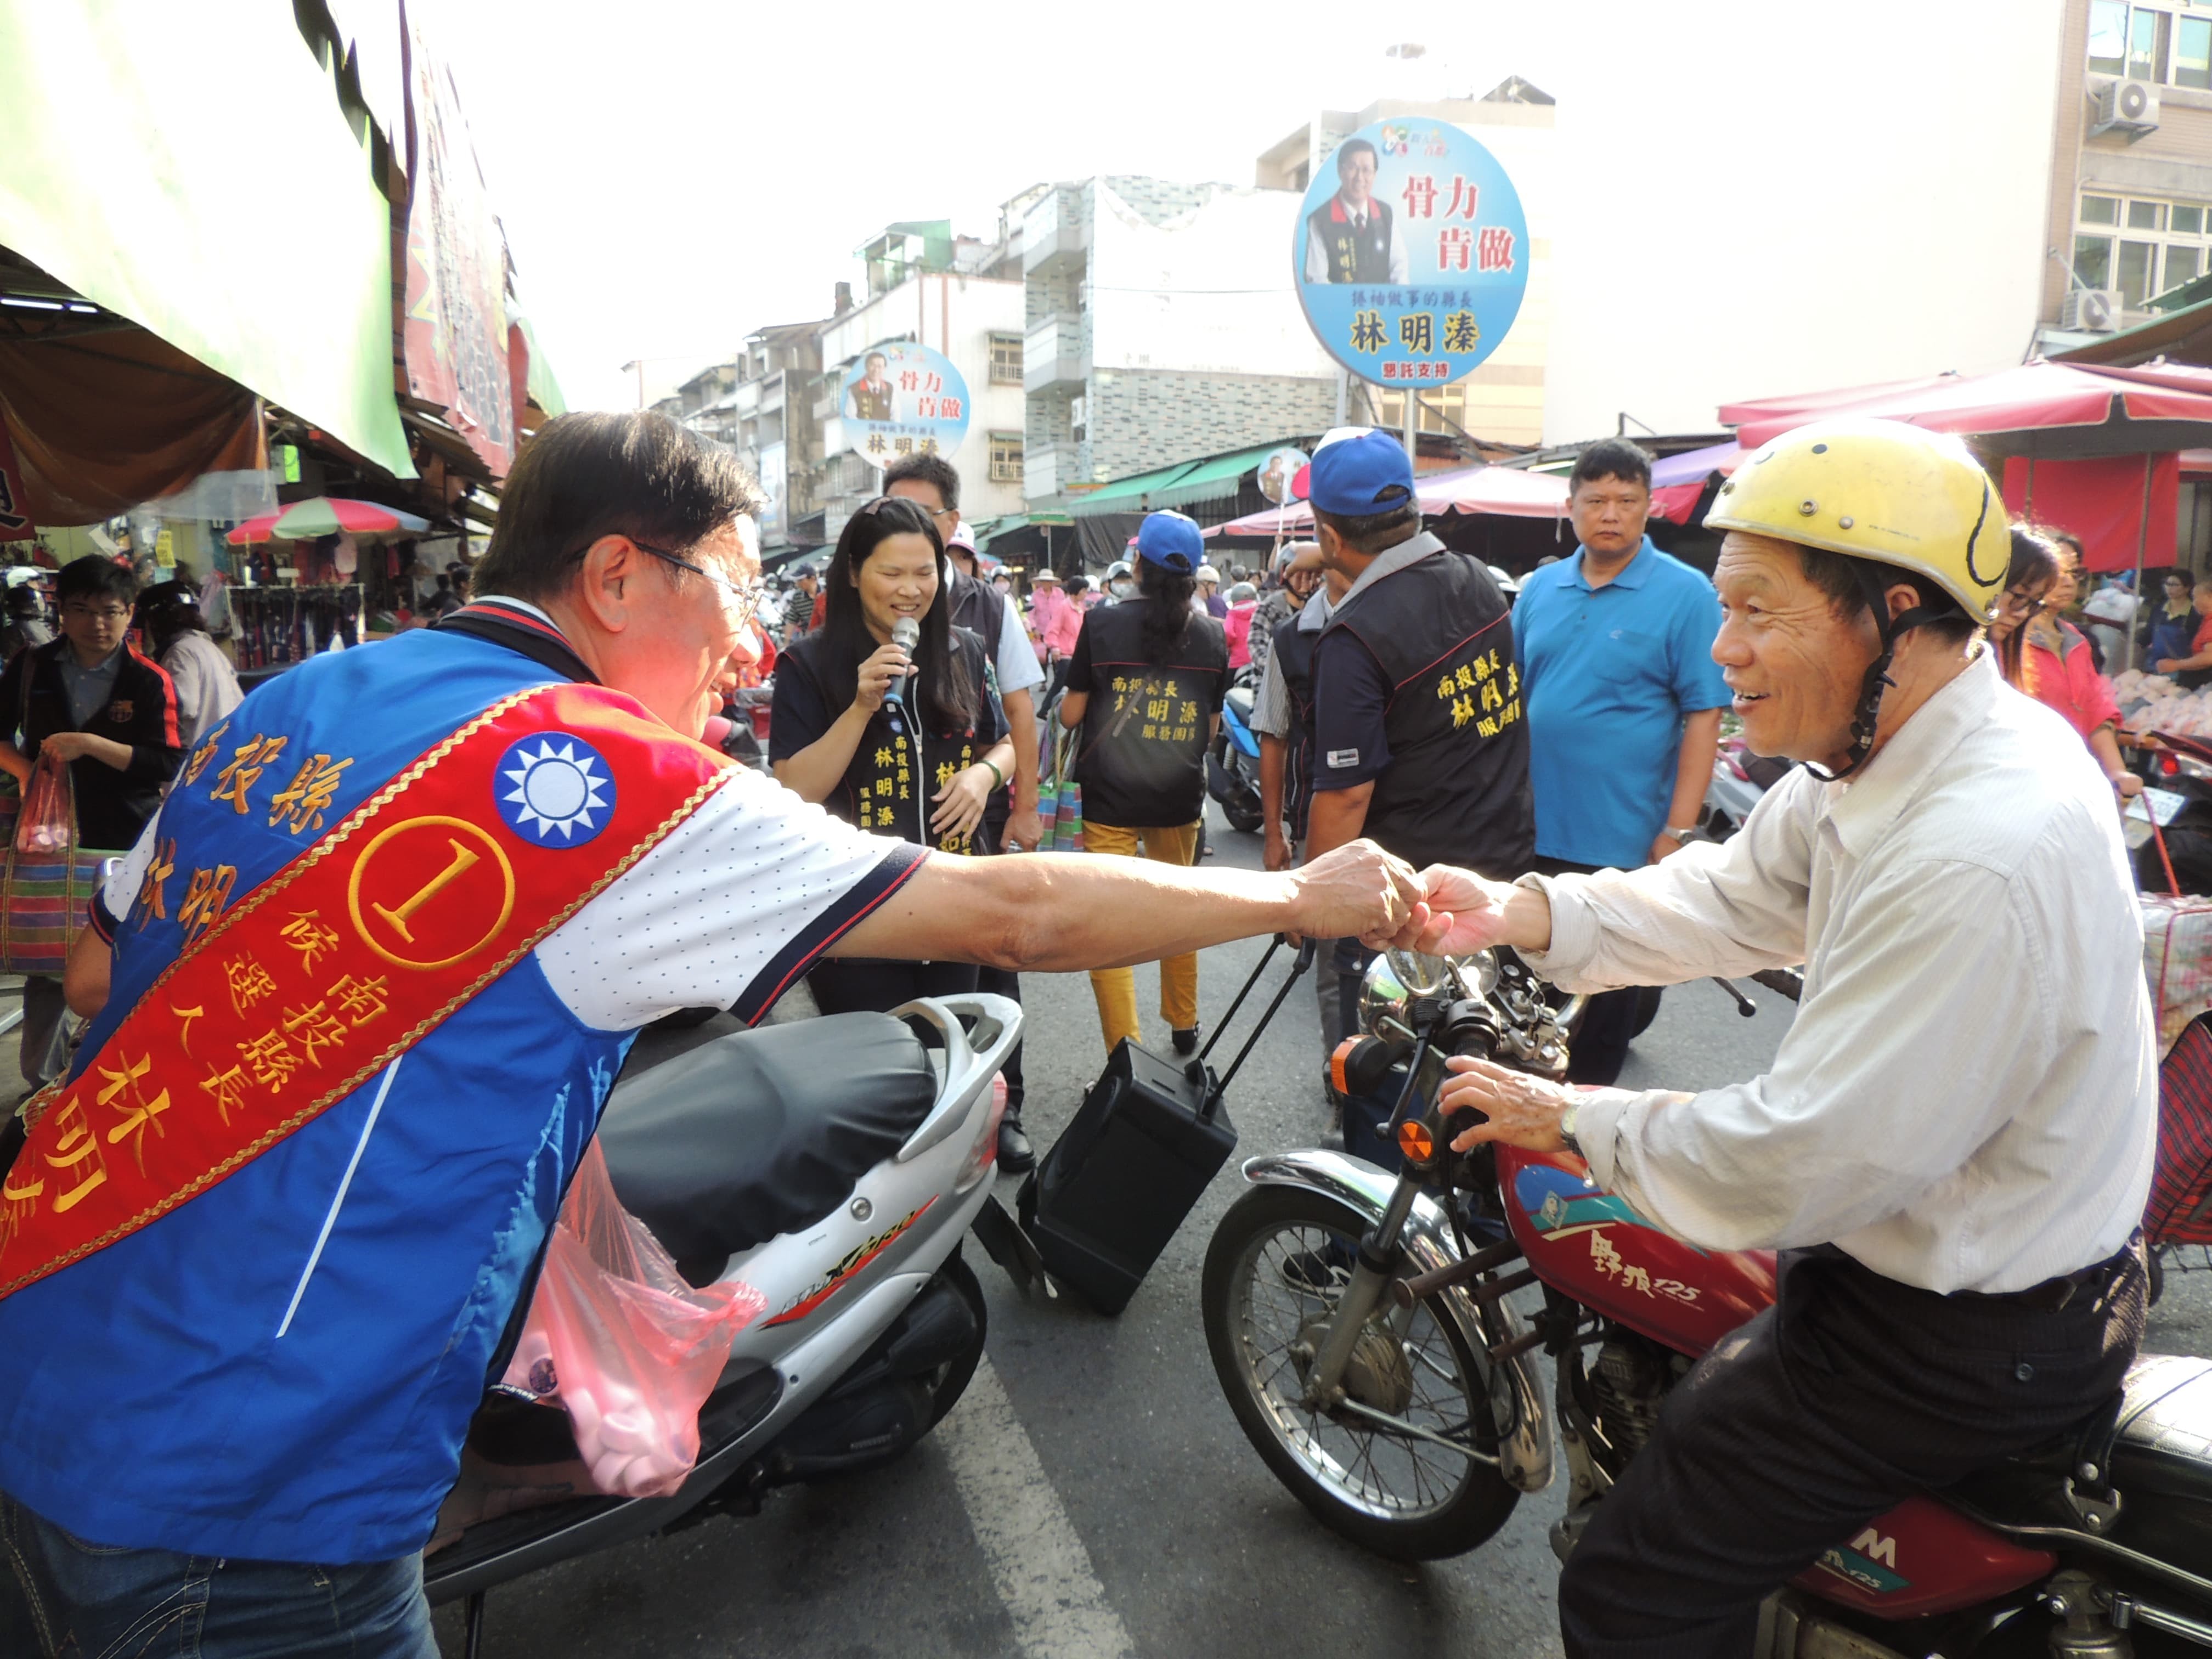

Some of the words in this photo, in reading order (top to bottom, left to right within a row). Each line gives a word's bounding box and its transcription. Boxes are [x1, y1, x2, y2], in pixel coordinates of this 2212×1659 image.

[1402, 174, 1479, 220] 骨力
[1438, 227, 1516, 272] 肯做
[1350, 309, 1480, 356] 林明溱
[170, 909, 339, 1059] 候選人
[199, 974, 389, 1127] 南投縣長
